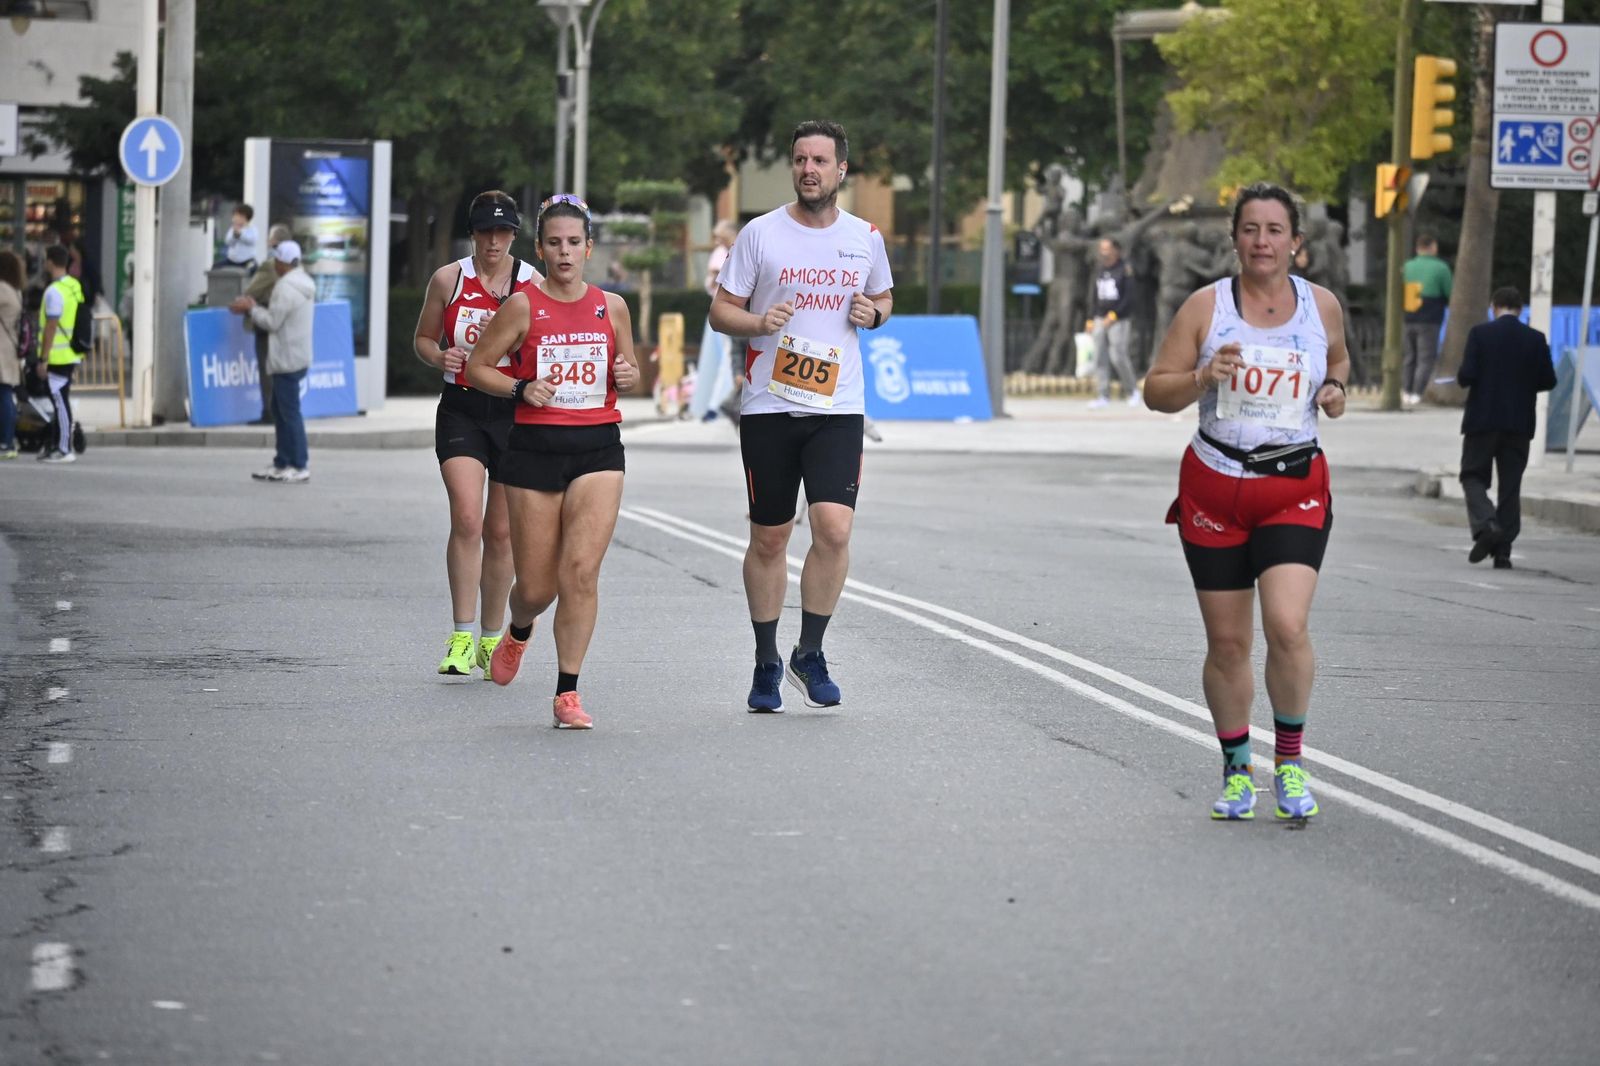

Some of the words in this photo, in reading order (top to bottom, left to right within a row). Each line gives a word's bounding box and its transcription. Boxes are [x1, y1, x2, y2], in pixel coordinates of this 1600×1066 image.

[779, 267, 836, 287] AMIGOS
[841, 269, 859, 287] DE
[795, 292, 845, 311] DANNY
[541, 334, 567, 345] SAN
[569, 333, 607, 343] PEDRO
[542, 348, 556, 358] 2K
[590, 346, 603, 357] 2K
[1288, 352, 1303, 366] 2K
[202, 352, 259, 389] Huelv
[550, 361, 596, 386] 848
[781, 352, 832, 384] 205
[1231, 365, 1300, 399] 1071
[555, 395, 585, 404] Huelva
[784, 385, 813, 401] Huelva
[1239, 404, 1277, 420] Huelva
